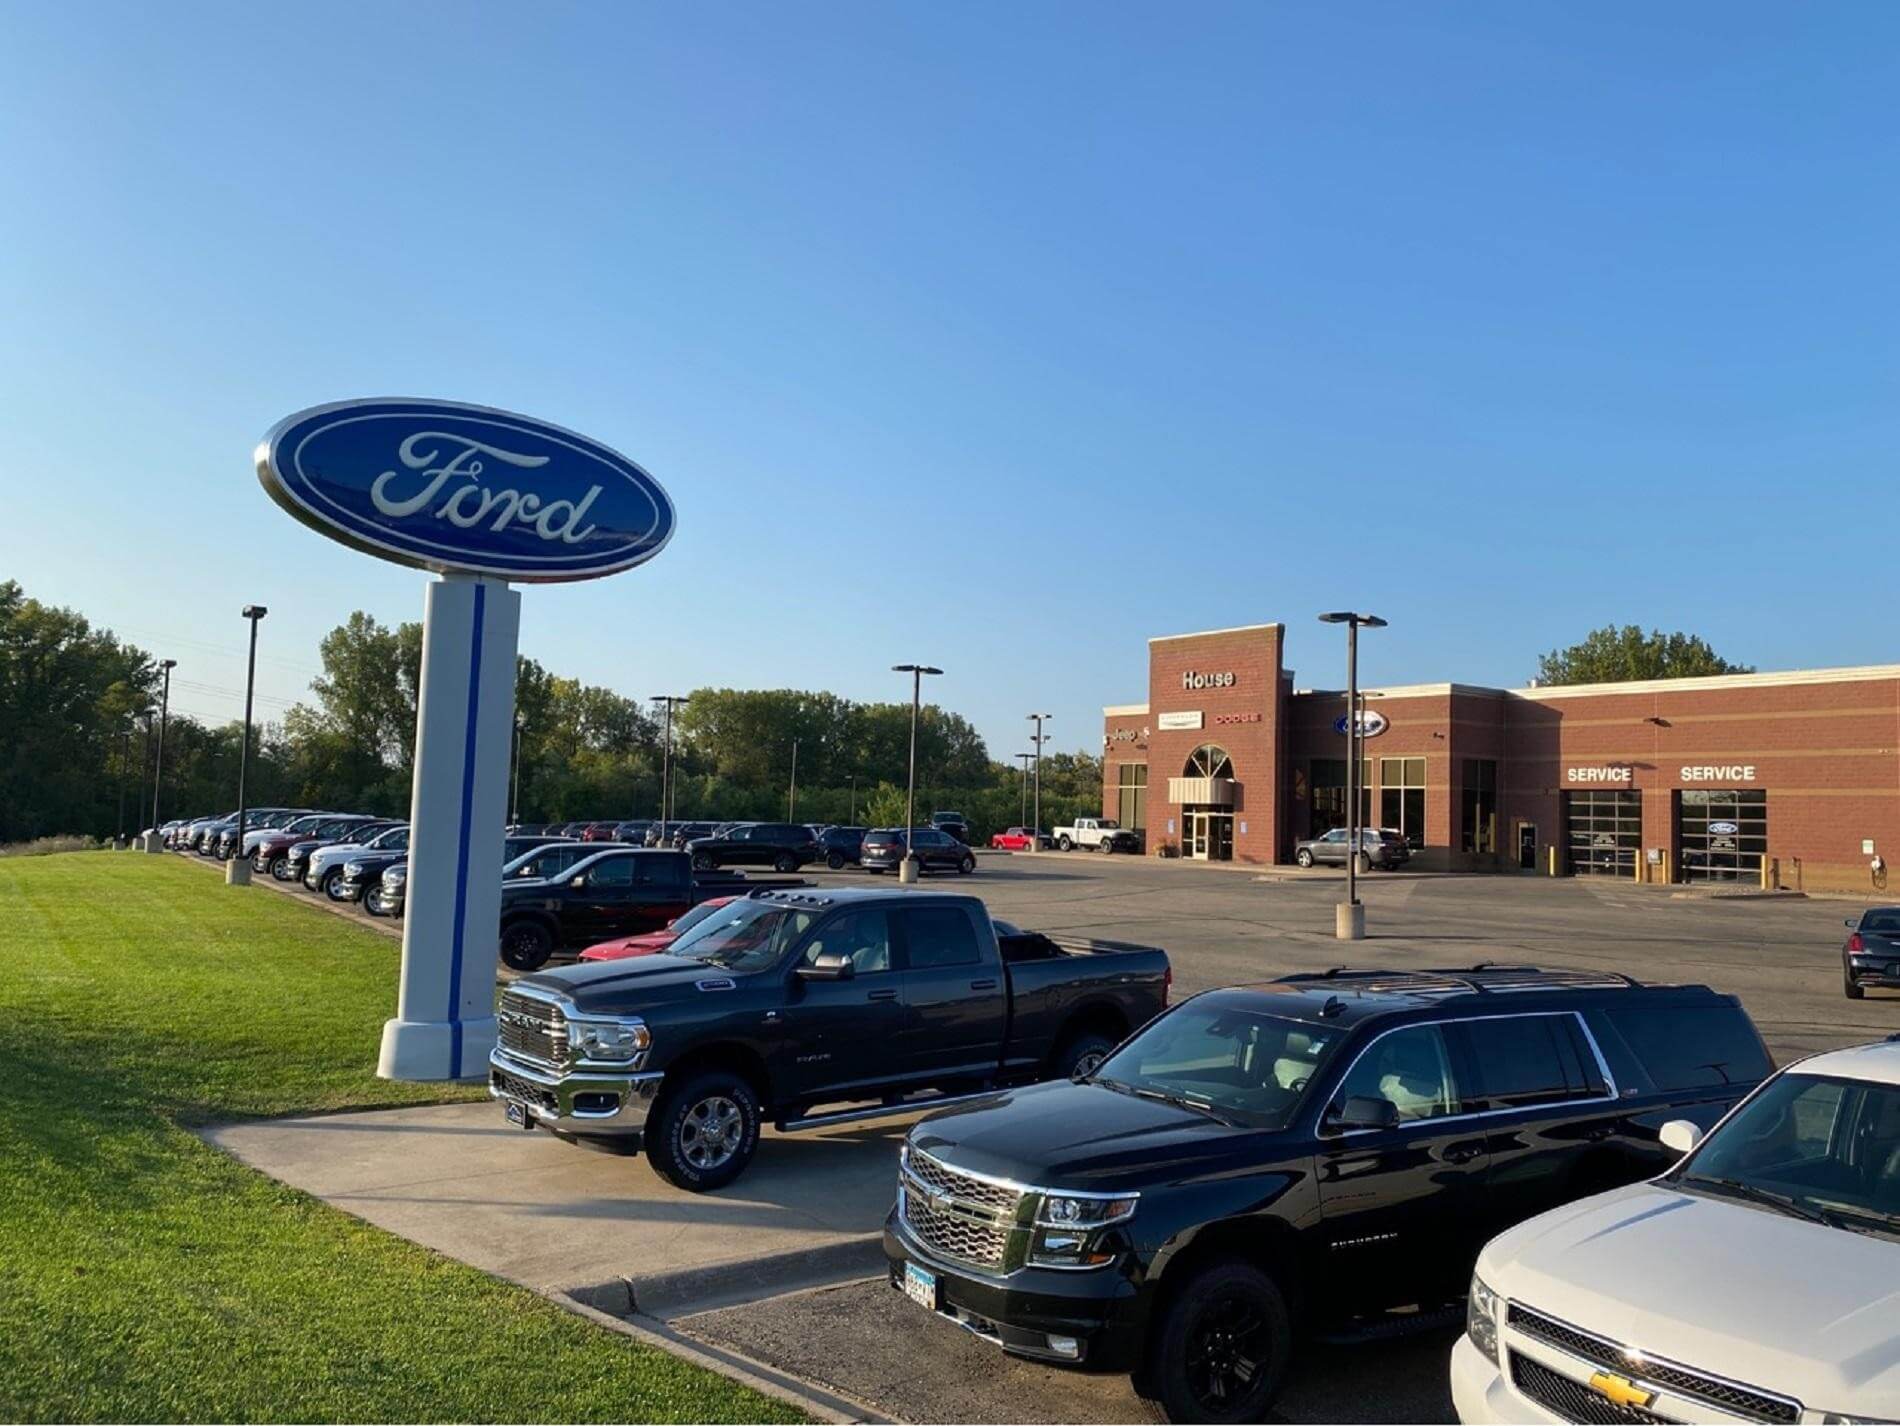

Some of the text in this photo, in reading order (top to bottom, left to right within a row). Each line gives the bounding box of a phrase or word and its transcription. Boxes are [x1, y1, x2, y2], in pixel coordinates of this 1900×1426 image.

[370, 431, 604, 544] Ford
[1183, 671, 1234, 689] House
[1567, 767, 1632, 782] SERVICE
[1680, 766, 1755, 781] SERVICE
